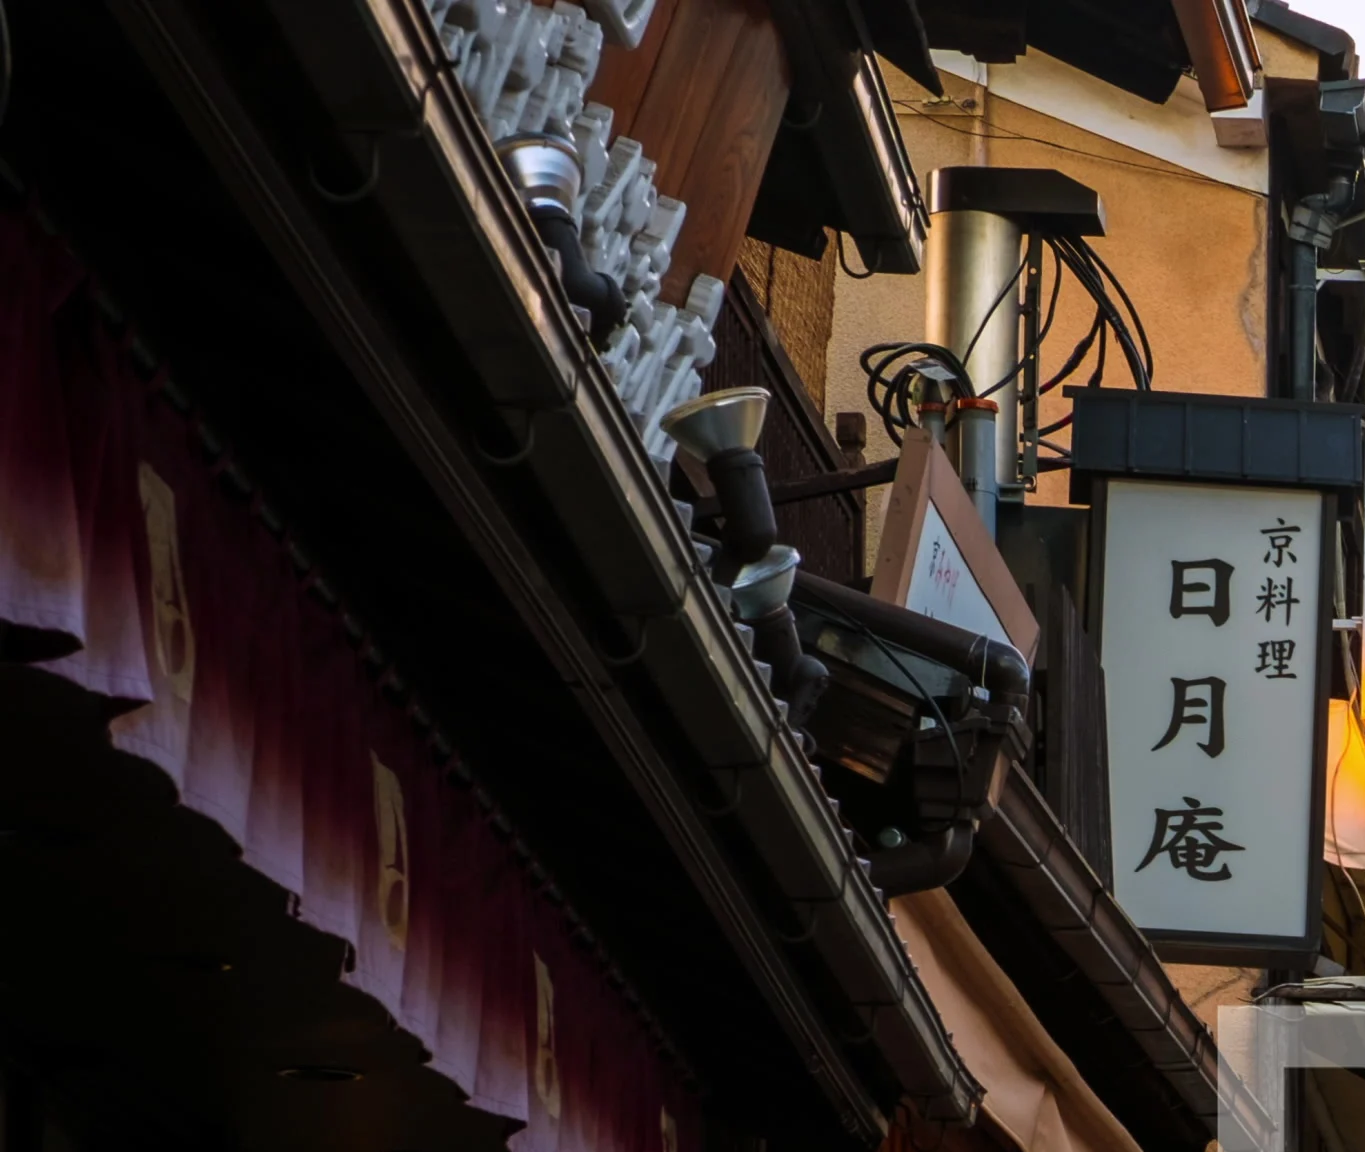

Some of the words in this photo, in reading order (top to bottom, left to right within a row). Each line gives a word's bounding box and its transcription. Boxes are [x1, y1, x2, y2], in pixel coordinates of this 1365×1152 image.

[1134, 557, 1247, 882] 日月庵
[1255, 518, 1301, 680] 京料理
